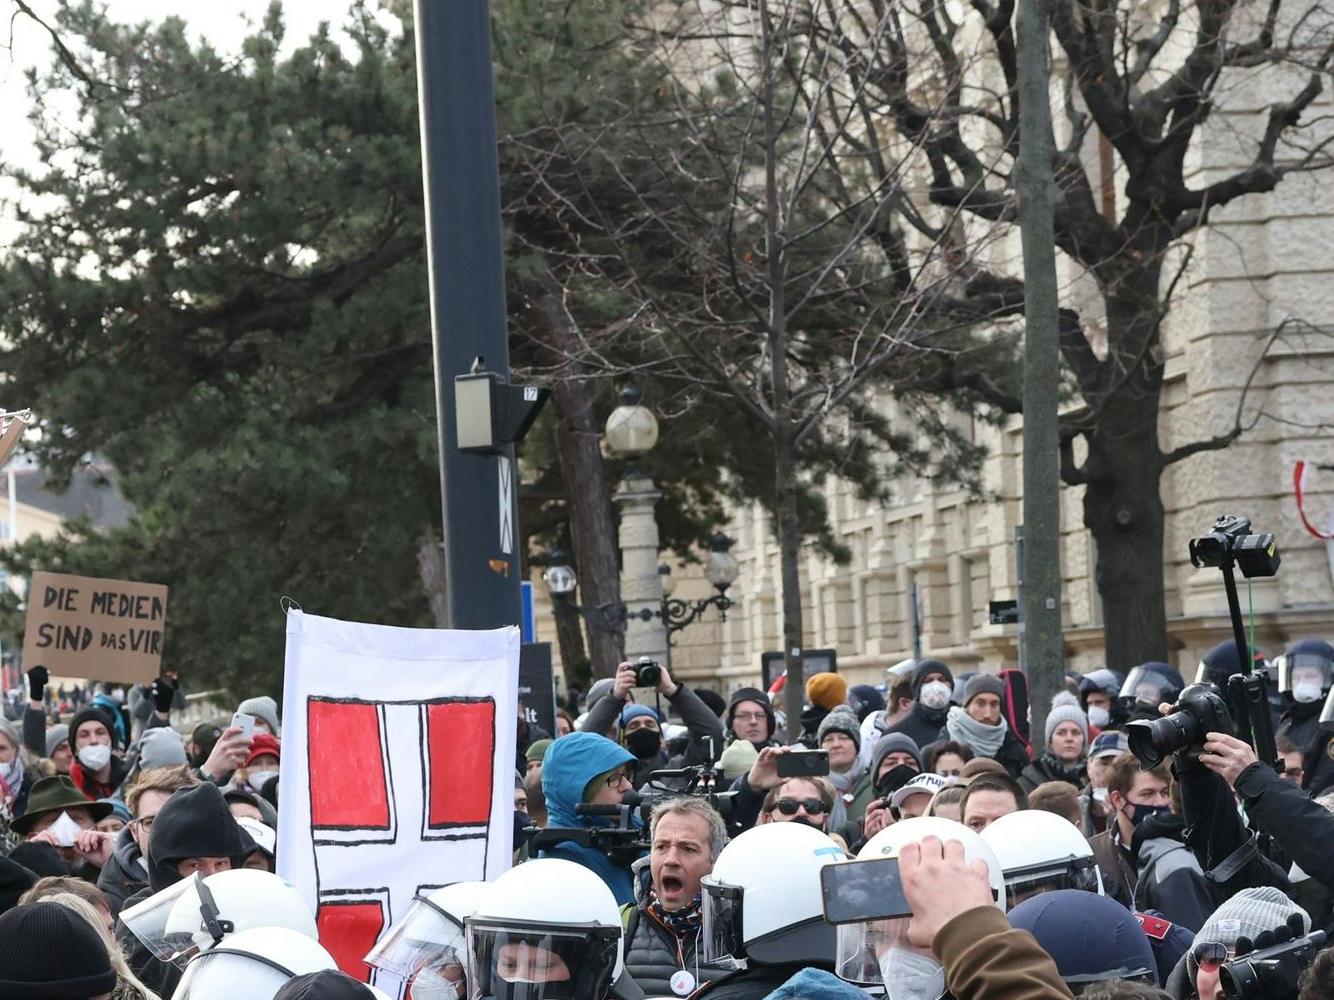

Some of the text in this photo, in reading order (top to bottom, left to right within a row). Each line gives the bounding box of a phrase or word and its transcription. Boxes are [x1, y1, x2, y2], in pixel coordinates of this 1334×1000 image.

[43, 586, 163, 620] DIE MEDIEN
[35, 622, 93, 652] SIND
[100, 632, 126, 650] DAS
